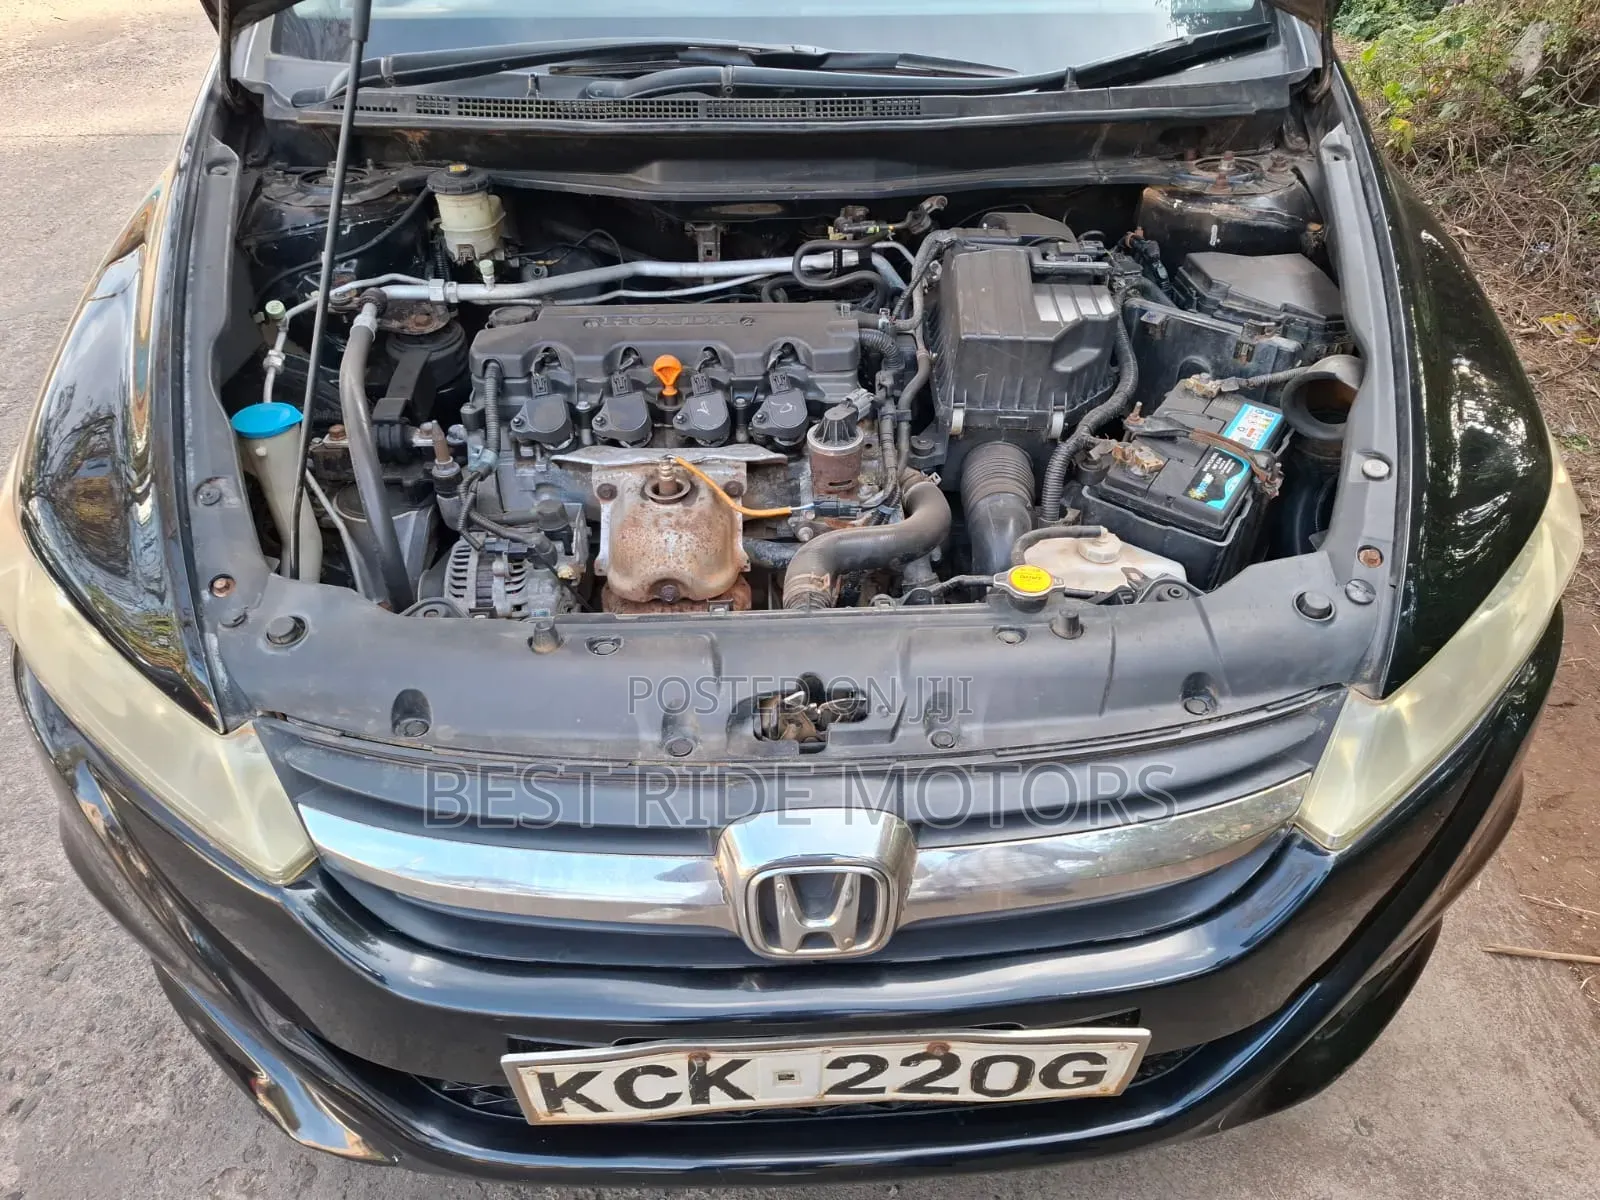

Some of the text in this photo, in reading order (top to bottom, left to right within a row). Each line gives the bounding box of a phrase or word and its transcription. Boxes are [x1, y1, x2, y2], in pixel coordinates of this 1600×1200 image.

[599, 315, 739, 328] HONDA
[537, 1051, 1108, 1114] KCK 220G
